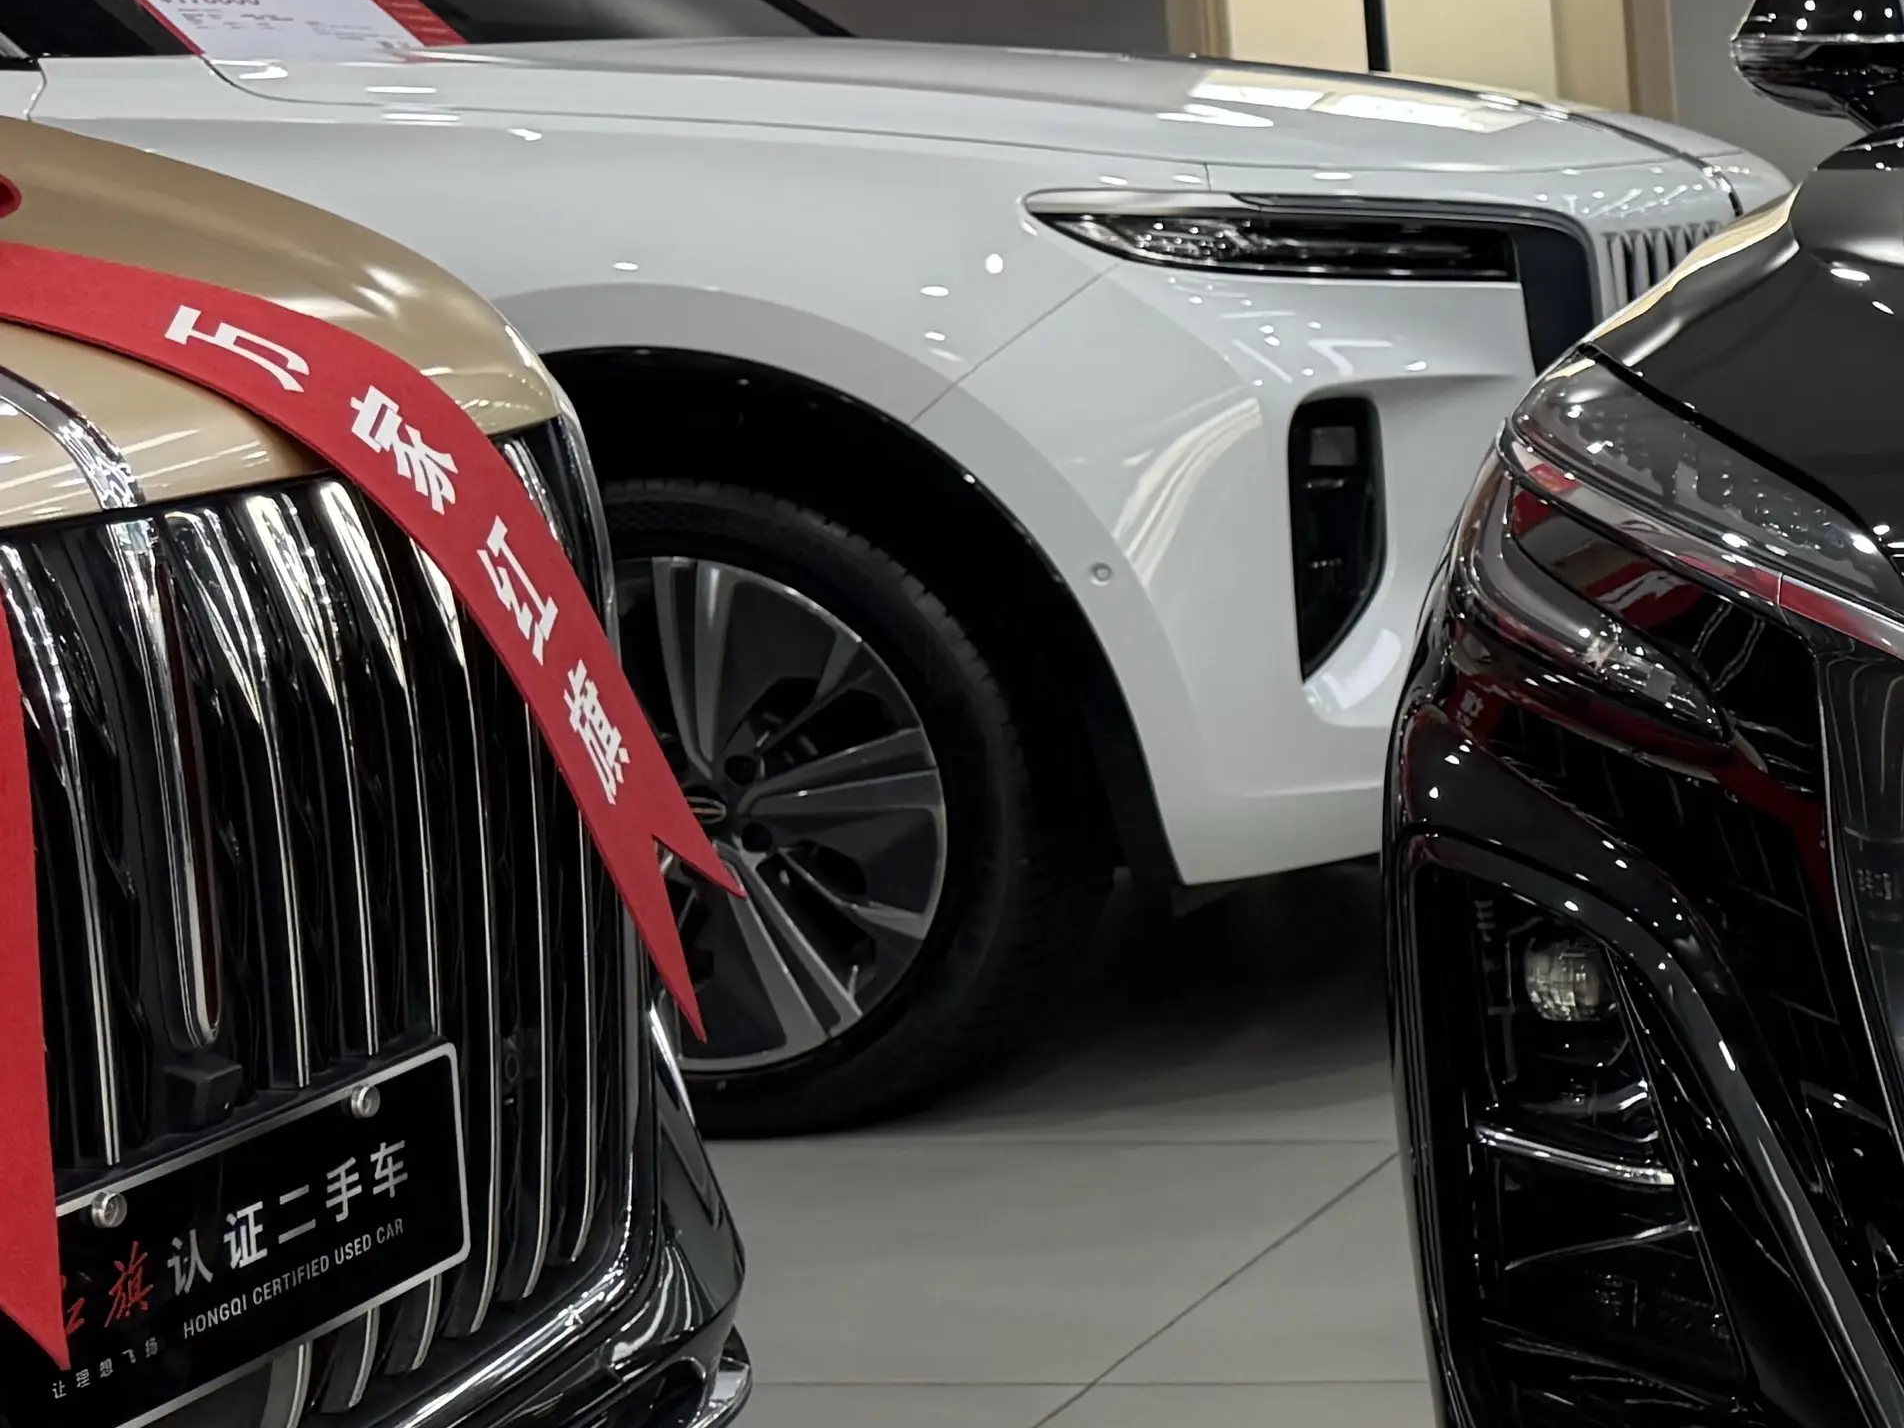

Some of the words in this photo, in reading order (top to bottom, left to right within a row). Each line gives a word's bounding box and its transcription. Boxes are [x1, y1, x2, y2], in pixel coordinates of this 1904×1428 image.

[164, 303, 631, 805] 万家红旗
[182, 1293, 247, 1340] HONGQI
[252, 1255, 330, 1306] CERTIFIED
[334, 1233, 372, 1265] USED
[376, 1217, 404, 1244] CAR
